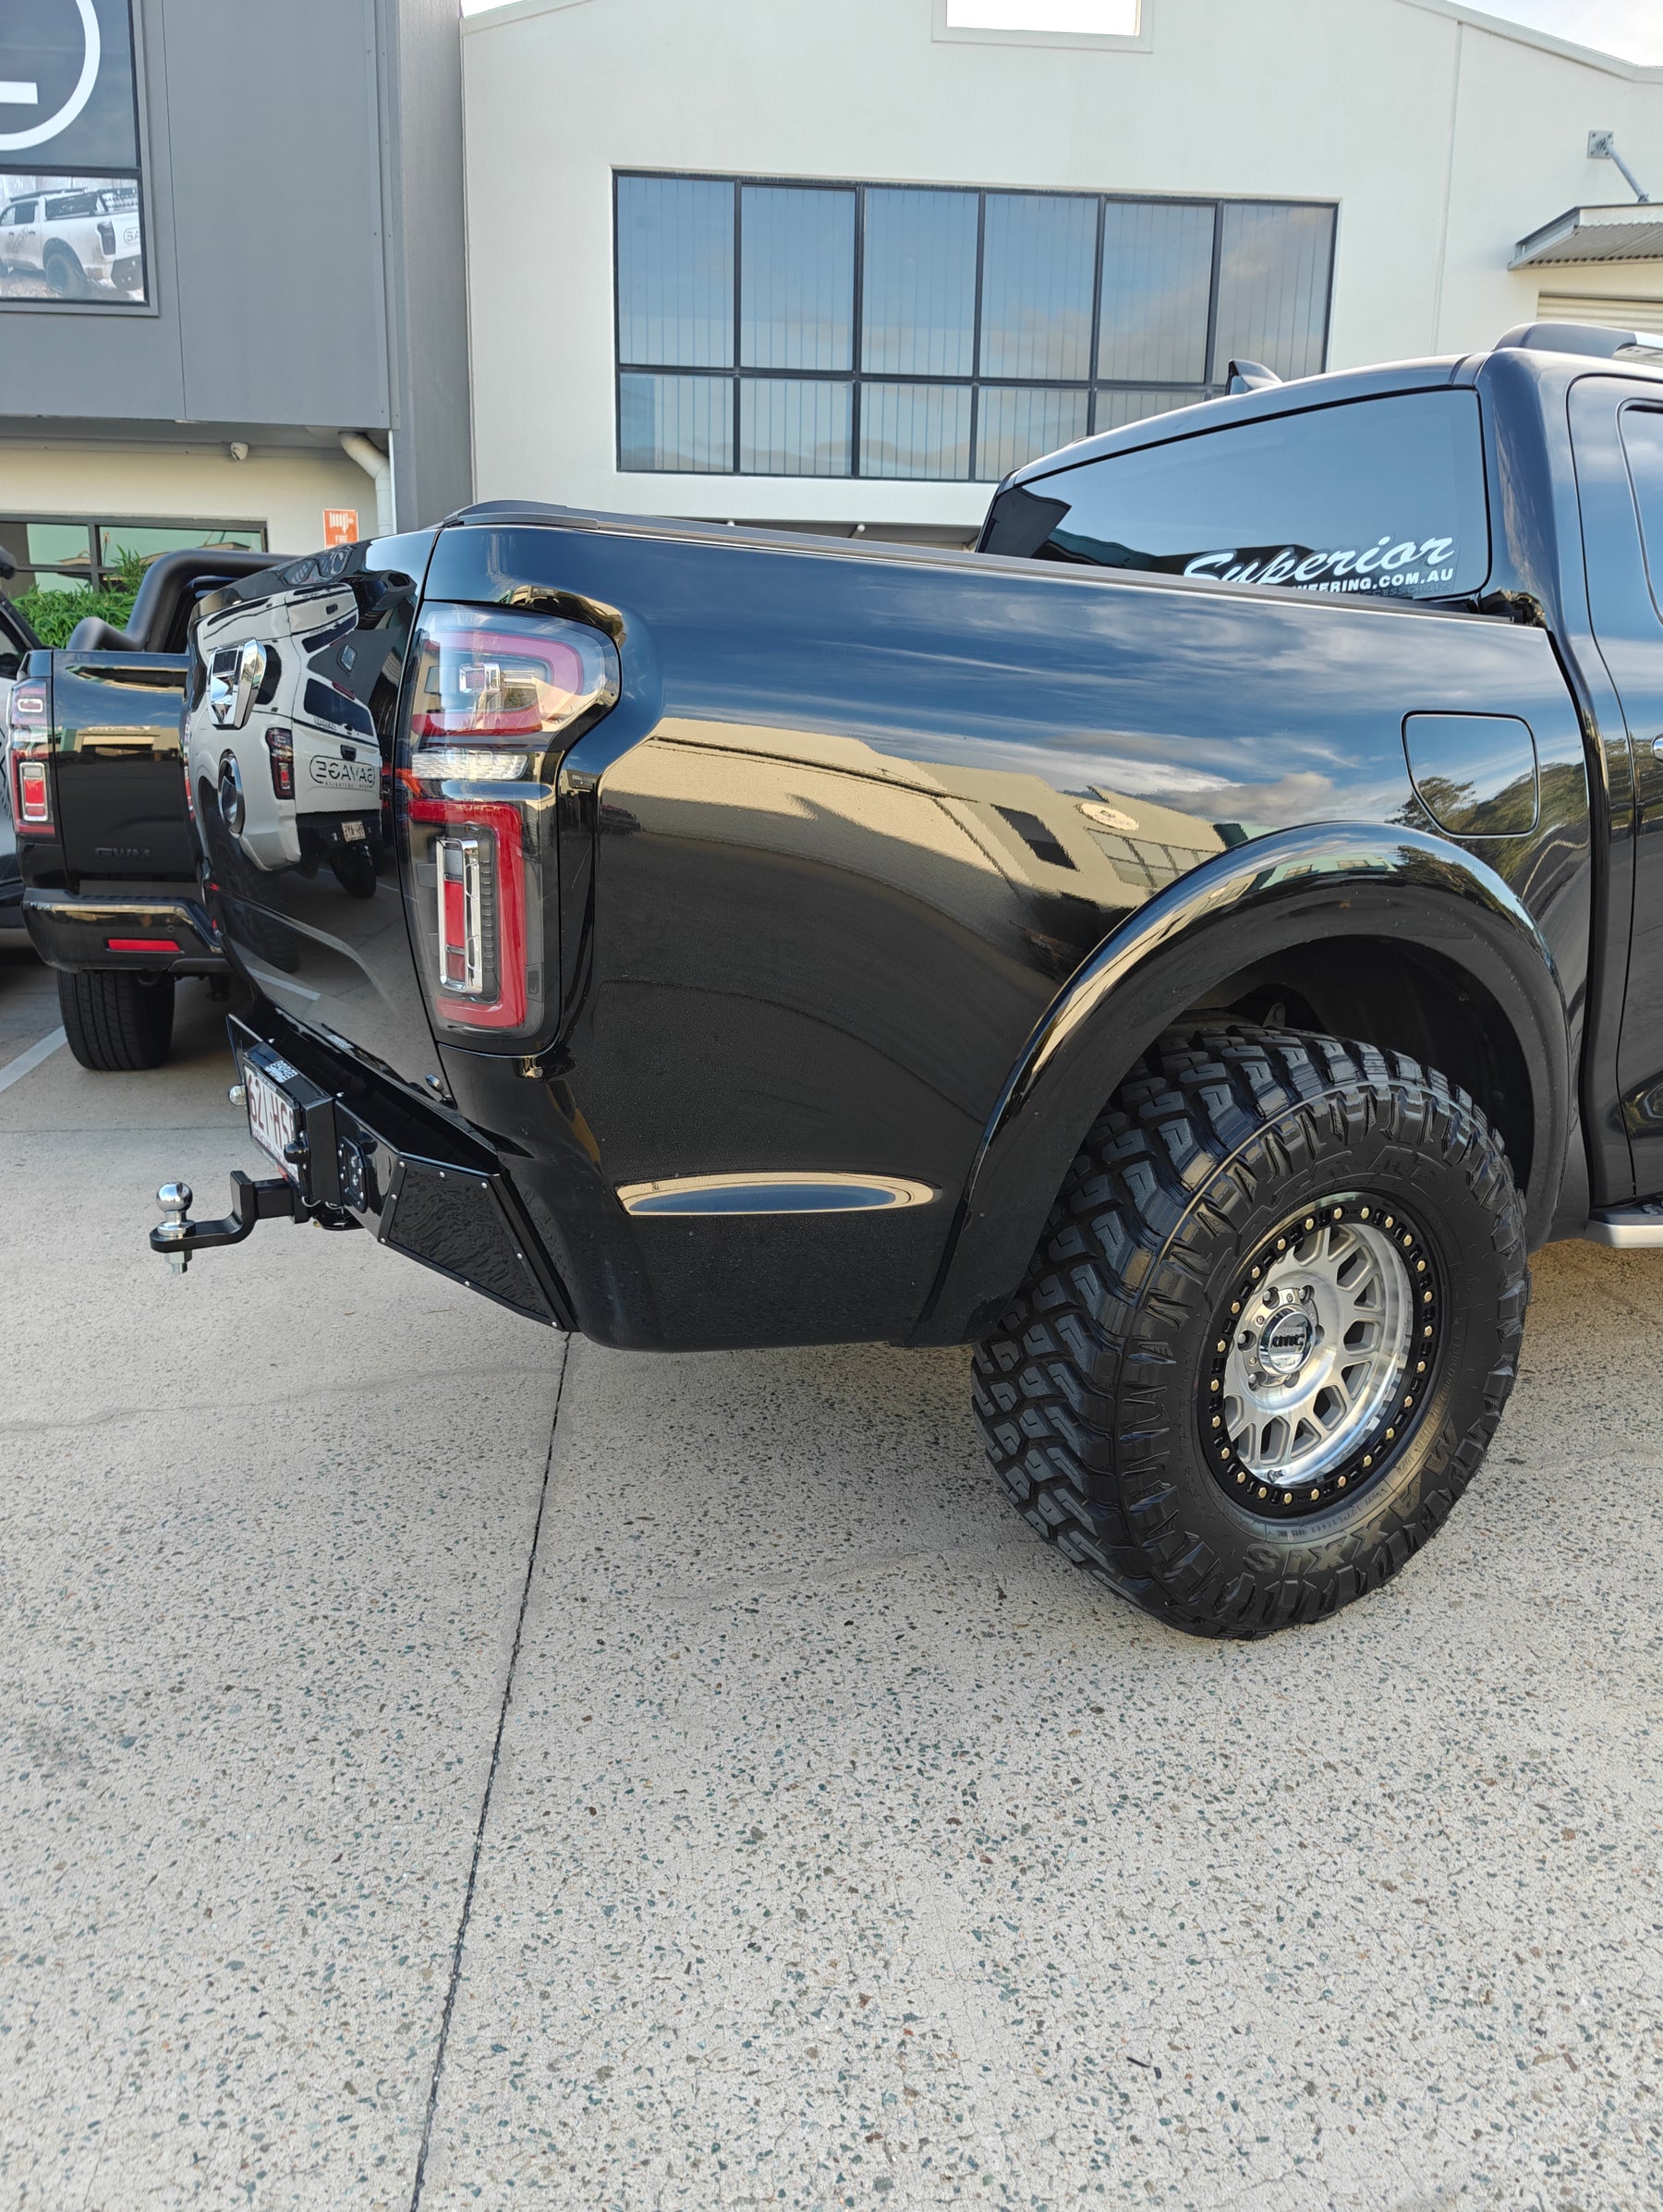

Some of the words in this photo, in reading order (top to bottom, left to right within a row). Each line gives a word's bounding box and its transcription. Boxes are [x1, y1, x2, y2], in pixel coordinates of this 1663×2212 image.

[1184, 536, 1454, 585] Superior
[95, 847, 151, 857] GWM
[1270, 1333, 1305, 1348] KMC
[1243, 1416, 1458, 1577] MAXXIS
